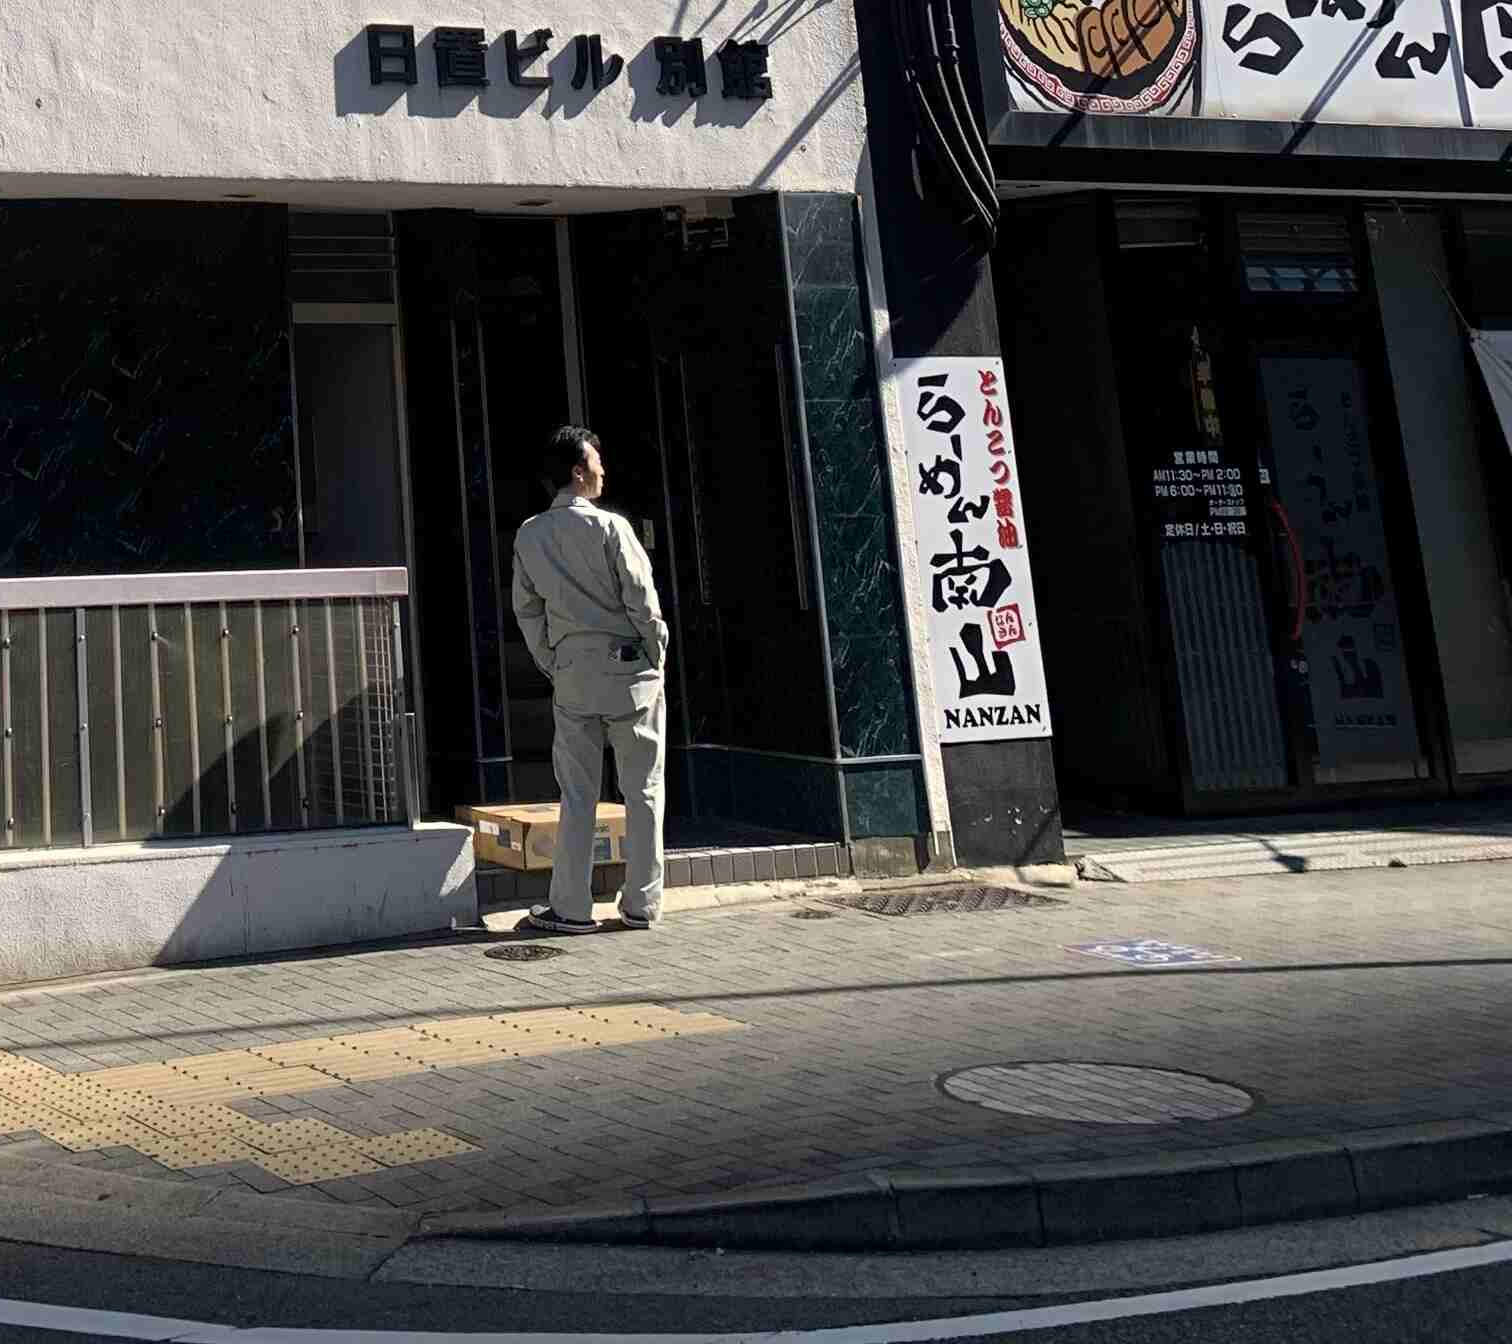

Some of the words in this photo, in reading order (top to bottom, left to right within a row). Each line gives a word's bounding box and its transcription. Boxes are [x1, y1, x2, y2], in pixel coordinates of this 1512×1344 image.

[977, 369, 1020, 550] とんこつ醤油
[944, 703, 1042, 730] NANZAN
